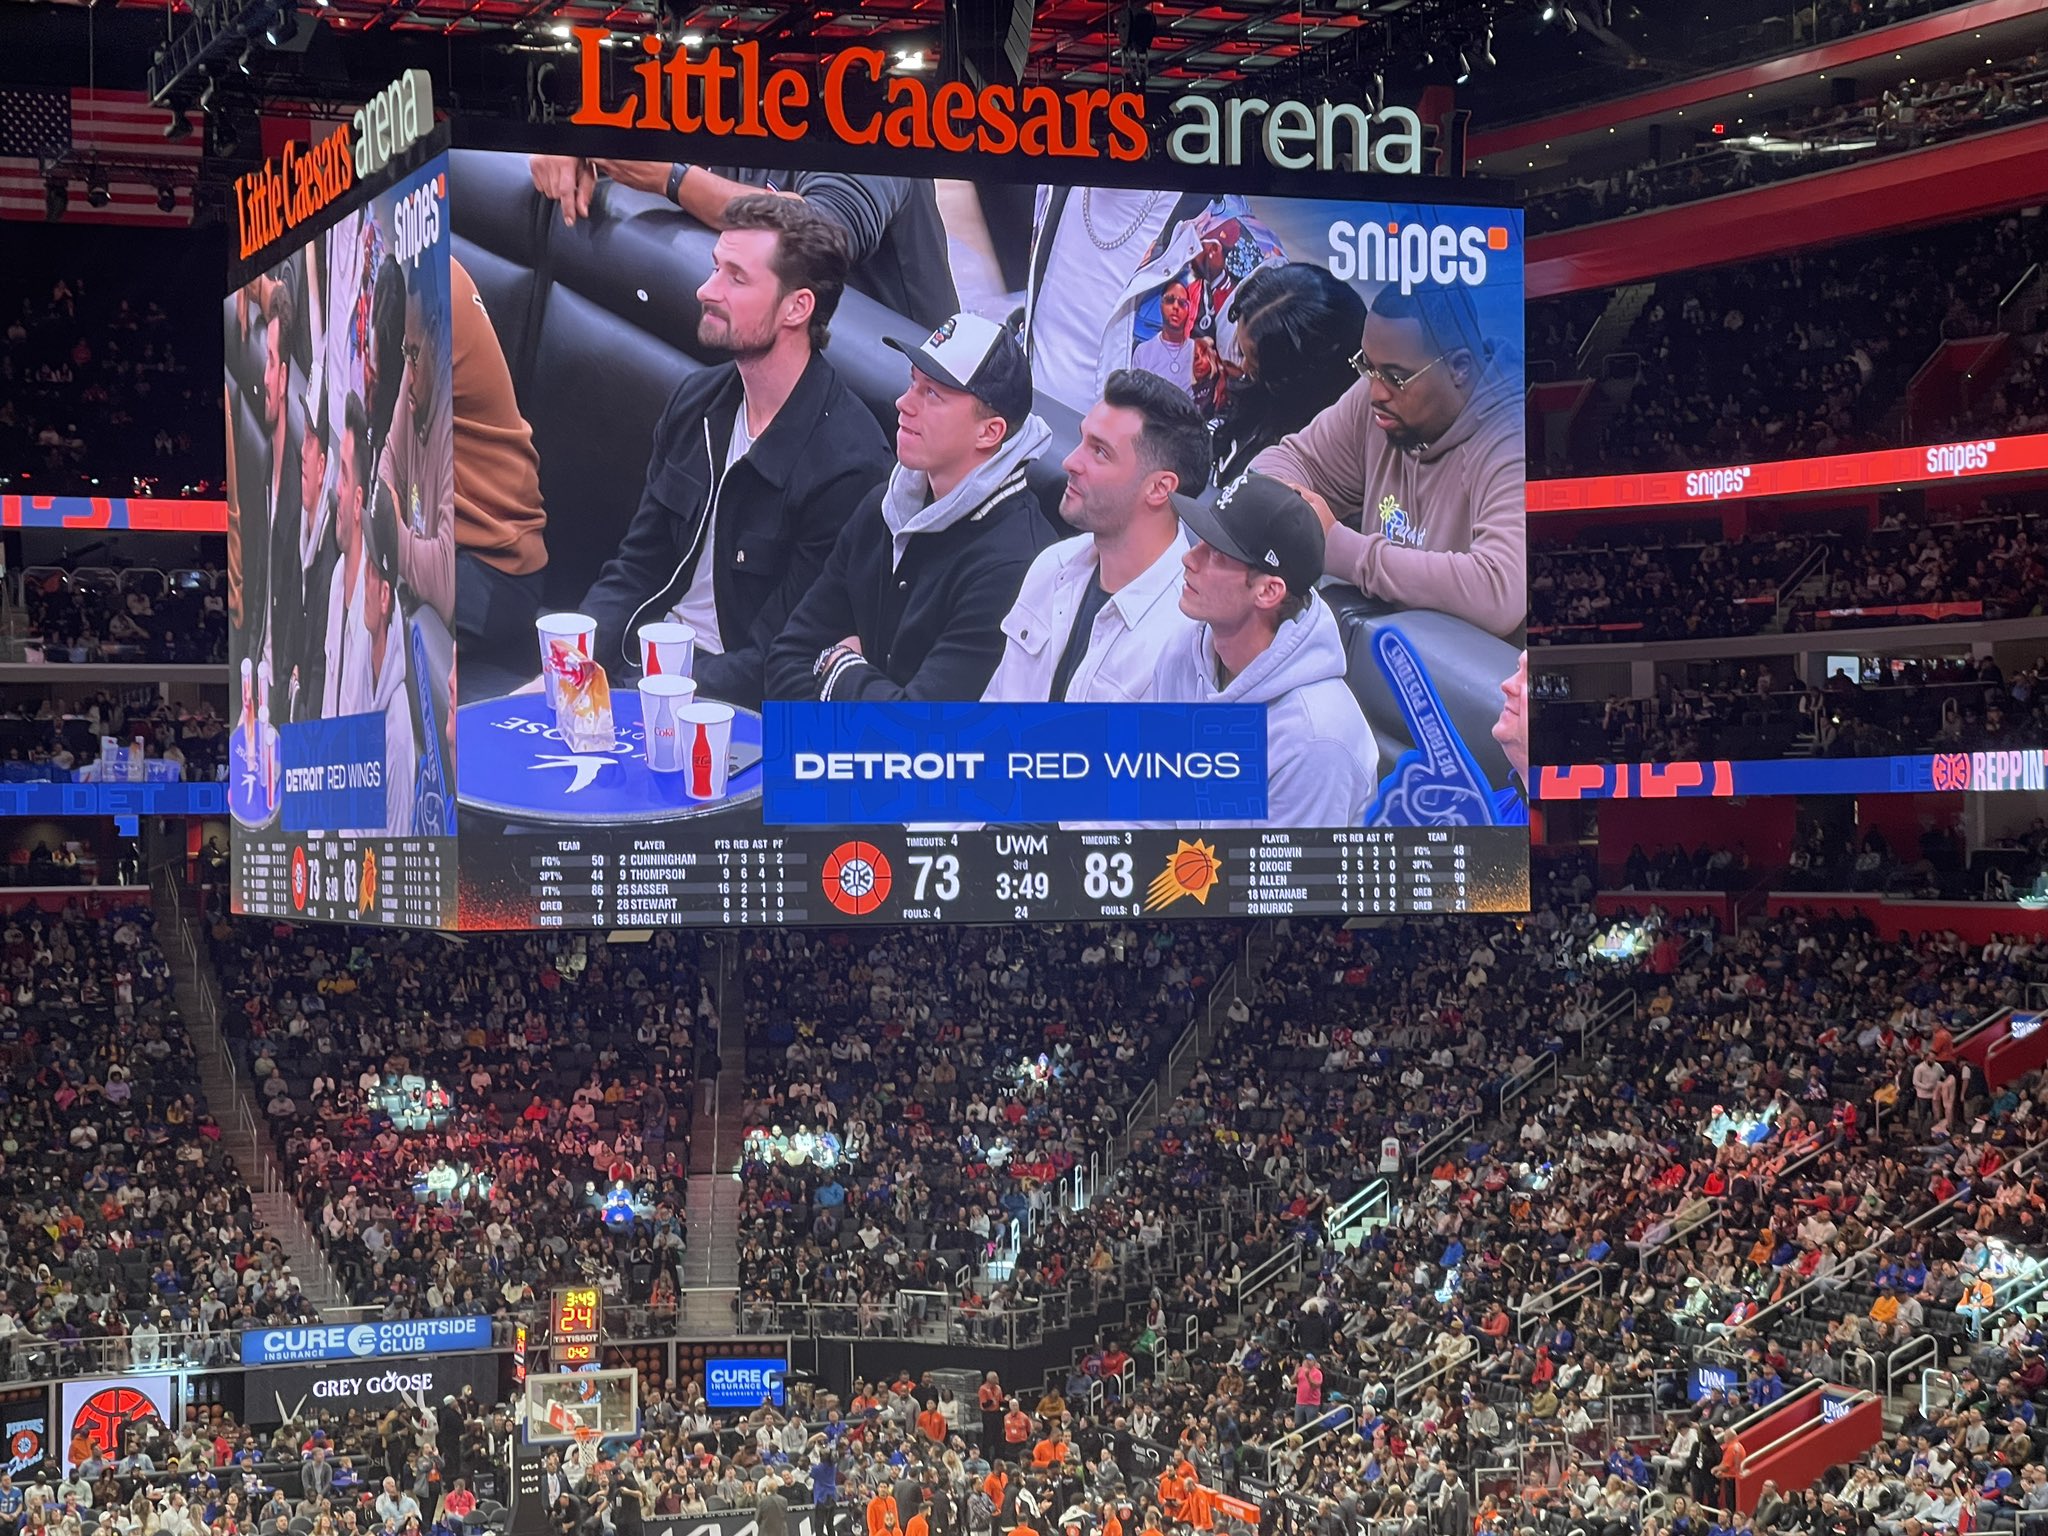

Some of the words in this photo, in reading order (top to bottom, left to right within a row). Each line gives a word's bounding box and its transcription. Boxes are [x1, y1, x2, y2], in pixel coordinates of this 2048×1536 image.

[570, 26, 810, 140] Little
[823, 46, 1149, 162] Caesars
[1167, 94, 1423, 174] arena
[234, 157, 284, 260] Little
[282, 122, 353, 229] Caesars
[354, 68, 434, 180] arena
[394, 173, 446, 268] snipes
[1328, 220, 1508, 296] snipes
[1686, 467, 1750, 500] snipes
[1926, 441, 1996, 476] snipes
[794, 752, 984, 780] DETROIT
[1008, 752, 1090, 780] RED
[1104, 752, 1241, 780] WINGS
[286, 766, 324, 792] DETROIT
[327, 764, 346, 790] RED
[348, 761, 380, 788] WINGS
[906, 838, 946, 847] TIMEOUTS:
[951, 834, 958, 846] 4
[1081, 836, 1120, 845] TIMEOUTS:
[1124, 833, 1132, 844] 3
[1262, 834, 1290, 844] PLAYER
[1333, 834, 1347, 843] PTS
[1350, 834, 1364, 842] REB
[1367, 834, 1380, 842] AST
[1385, 833, 1394, 842] PF
[1428, 832, 1447, 842] TEAM
[558, 842, 580, 850] TEAM
[634, 841, 666, 850] PLAYER
[715, 840, 730, 850] PTS
[734, 840, 749, 849] REB
[752, 840, 768, 849] AST
[773, 840, 783, 849] PF
[996, 835, 1048, 855] UWM
[1454, 845, 1464, 855] 48
[1250, 848, 1256, 858] 0
[1260, 847, 1302, 858] GOODWIN
[1342, 846, 1348, 857] 0
[1357, 846, 1363, 856] 4
[1373, 846, 1379, 856] 3
[1391, 846, 1396, 856] 1
[592, 855, 604, 866] 50
[620, 855, 626, 865] 2
[630, 854, 696, 865] CUNNINGHAM
[718, 854, 729, 865] 17
[741, 854, 747, 864] 3
[759, 853, 765, 864] 5
[776, 853, 783, 864] 2
[1013, 860, 1028, 870] 3rd
[1454, 860, 1465, 869] 40
[1250, 862, 1255, 872] 2
[1260, 861, 1292, 872] OKOGIE
[1342, 860, 1348, 870] 9
[1357, 860, 1363, 870] 5
[1373, 860, 1379, 870] 2
[1390, 860, 1396, 870] 0
[591, 870, 603, 881] 44
[620, 870, 626, 880] 9
[630, 869, 686, 880] THOMPSON
[723, 868, 730, 879] 9
[741, 868, 747, 879] 6
[759, 868, 765, 879] 4
[779, 867, 784, 878] 1
[908, 854, 960, 900] 73
[1084, 852, 1134, 898] 83
[1250, 876, 1256, 886] 8
[1260, 875, 1287, 885] ALLEN
[1337, 874, 1348, 884] 12
[1358, 874, 1363, 884] 3
[1375, 874, 1380, 884] 1
[1390, 873, 1396, 884] 0
[1454, 873, 1465, 883] 90
[307, 858, 320, 901] 73
[344, 858, 357, 903] 83
[996, 872, 1049, 900] 3:49
[592, 884, 603, 896] 86
[617, 884, 628, 895] 25
[630, 884, 669, 895] SASSER
[718, 883, 729, 894] 16
[741, 882, 747, 894] 2
[761, 882, 766, 893] 1
[777, 882, 783, 893] 3
[1248, 889, 1258, 900] 18
[1260, 888, 1308, 900] WATANABE
[1342, 888, 1348, 898] 4
[1359, 888, 1364, 898] 1
[1374, 888, 1380, 898] 0
[1390, 887, 1396, 897] 0
[1459, 886, 1465, 896] 9
[597, 900, 604, 910] 7
[617, 899, 629, 910] 28
[630, 898, 678, 909] STEWART
[723, 897, 730, 908] 8
[741, 897, 747, 908] 2
[761, 897, 766, 908] 1
[777, 896, 784, 908] 0
[1248, 903, 1258, 914] 20
[1260, 902, 1293, 914] NURKIC
[1342, 902, 1348, 912] 4
[1358, 902, 1363, 912] 3
[1374, 901, 1380, 912] 6
[1390, 901, 1396, 912] 2
[1456, 900, 1466, 911] 21
[903, 908, 931, 919] FOULS:
[933, 907, 941, 919] 4
[1014, 906, 1028, 919] 24
[1101, 906, 1128, 916] FOULS:
[1133, 904, 1140, 916] 0
[592, 914, 604, 925] 16
[617, 914, 629, 925] 35
[630, 913, 668, 925] BAGLEY
[671, 913, 681, 924] III
[723, 912, 730, 923] 6
[741, 912, 747, 922] 2
[761, 912, 766, 922] 1
[777, 911, 783, 922] 3
[567, 1291, 596, 1307] 3:49
[561, 1308, 592, 1331] 24
[380, 1319, 476, 1339] COURTSIDE
[264, 1328, 345, 1352] CURE
[380, 1337, 425, 1353] CLUB
[565, 1334, 598, 1343] TISSOT
[264, 1349, 324, 1361] INSURANCE
[711, 1369, 761, 1383] CURE
[312, 1378, 363, 1398] GREY
[366, 1372, 433, 1394] GOOSE
